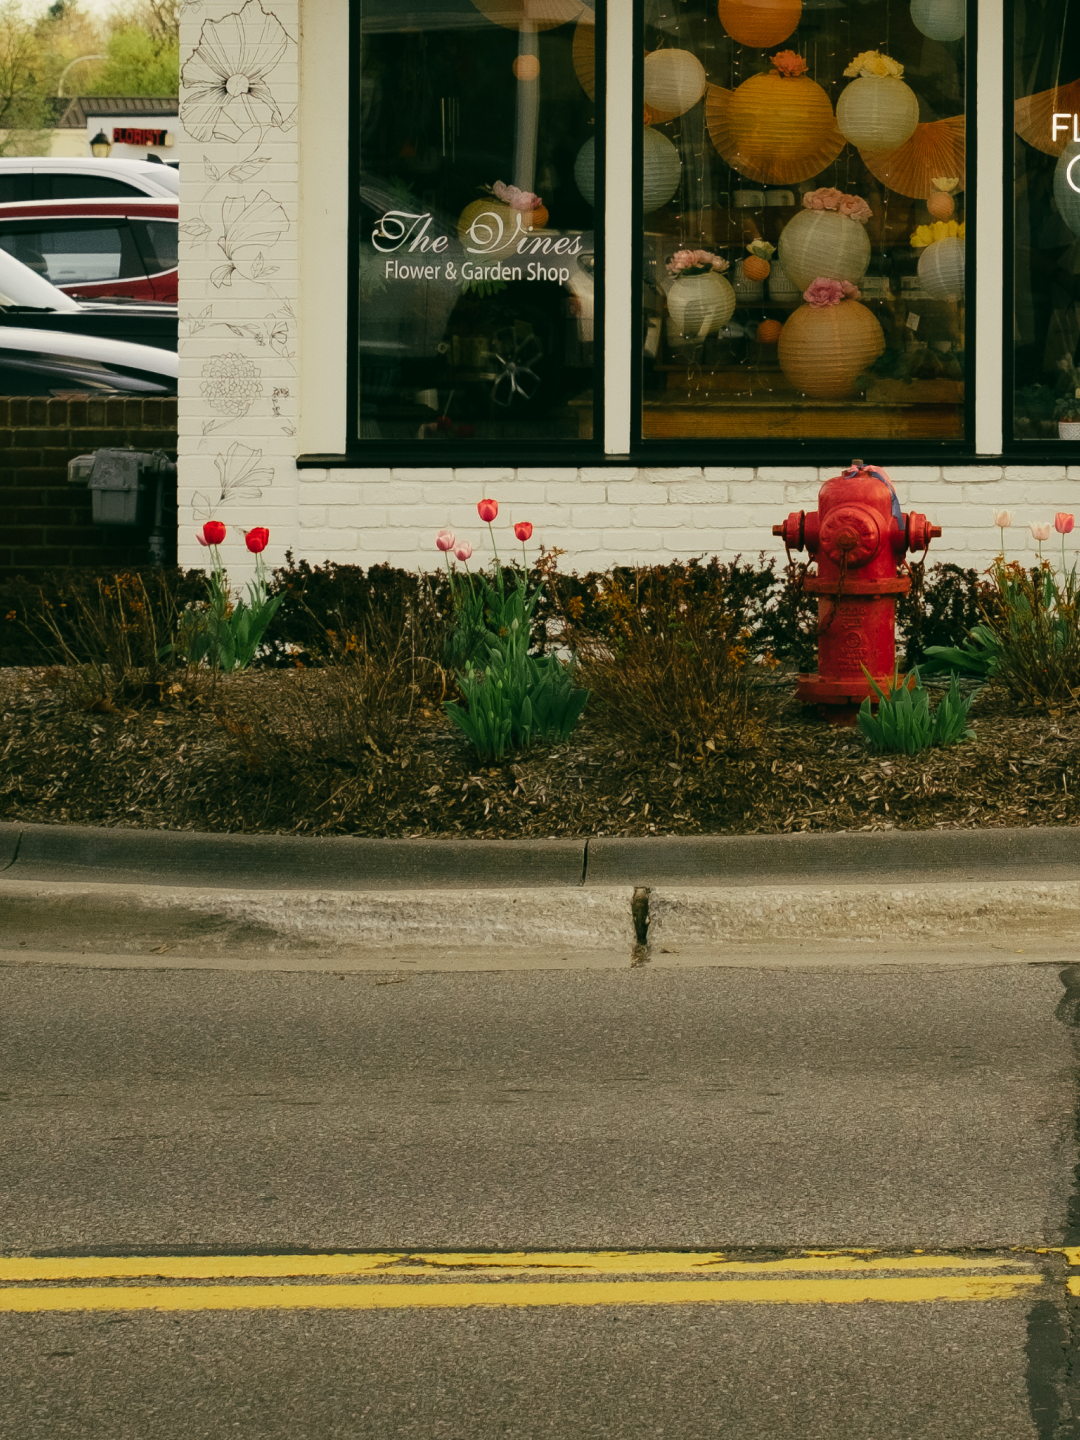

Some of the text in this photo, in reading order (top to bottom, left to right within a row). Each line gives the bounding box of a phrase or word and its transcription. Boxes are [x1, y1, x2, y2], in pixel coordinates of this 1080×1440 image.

[114, 128, 162, 146] FLORIST
[371, 209, 583, 255] The Vines
[385, 260, 570, 286] Flower & Garden Shop
